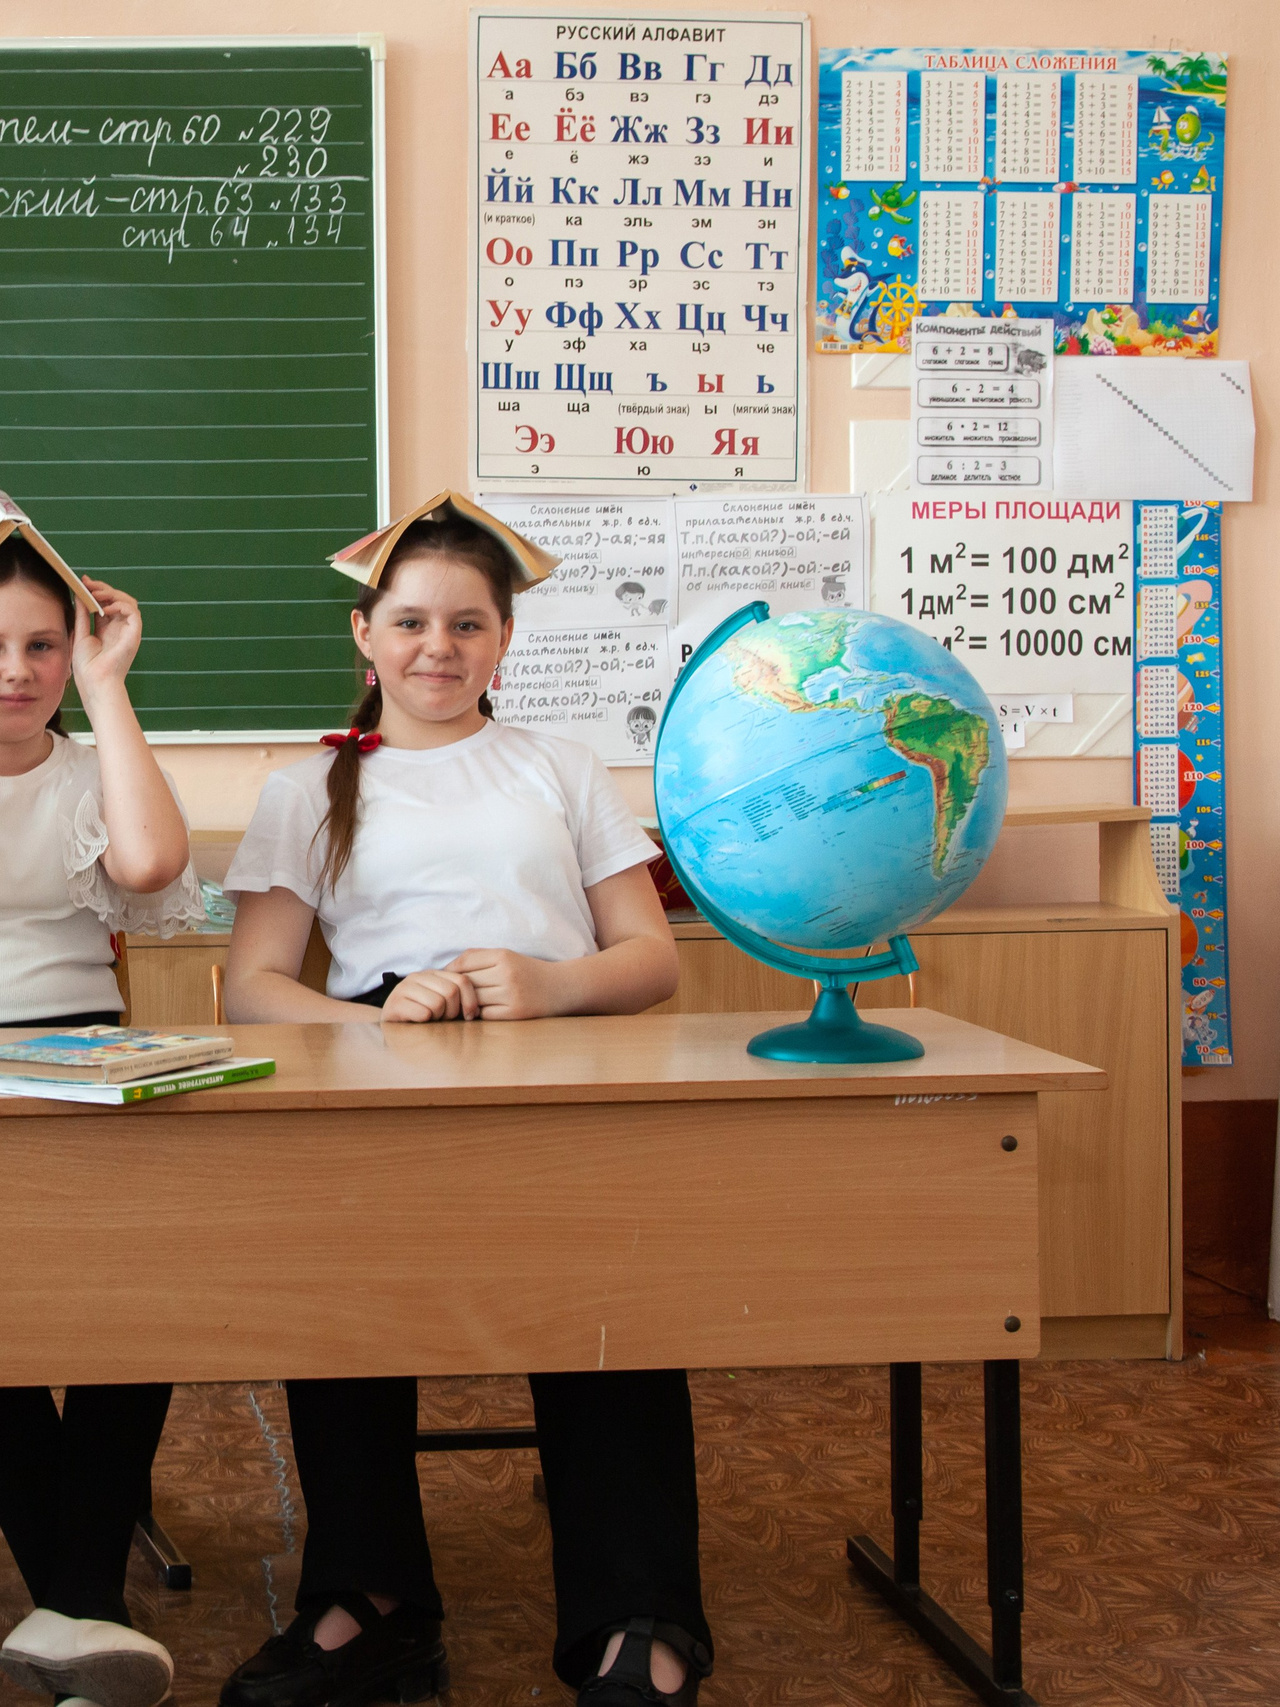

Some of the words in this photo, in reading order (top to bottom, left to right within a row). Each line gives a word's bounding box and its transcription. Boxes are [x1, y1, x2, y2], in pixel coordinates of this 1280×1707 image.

[557, 24, 635, 40] РУССКИЙ
[642, 27, 725, 42] АЛФАВИТ
[487, 51, 532, 78] Аа
[555, 52, 597, 80] Бб
[619, 53, 662, 80] Вв
[685, 54, 724, 81] Гг
[745, 55, 792, 88] Дд
[924, 54, 1009, 72] ТАБЛИЦА
[1015, 55, 1118, 71] СЛОЖЕНИЯ
[505, 90, 513, 100] а
[566, 88, 584, 101] бэ
[630, 93, 648, 102] вэ
[696, 94, 711, 103] гэ
[759, 95, 779, 106] дэ
[490, 113, 530, 141] Ее
[555, 107, 595, 142] Ёё
[611, 116, 668, 143] Жж
[686, 117, 720, 144] Зз
[744, 118, 793, 145] Ии
[505, 150, 513, 159] е
[570, 151, 578, 163] ё
[629, 155, 649, 164] жэ
[695, 156, 711, 165] зэ
[764, 157, 772, 166] и
[486, 168, 533, 203] Йй
[552, 177, 599, 204] Кк
[613, 178, 662, 205] Лл
[674, 179, 730, 206] Мм
[744, 180, 792, 207] Нн
[484, 213, 492, 224] (и
[496, 214, 535, 226] краткое)
[566, 216, 582, 225] ка
[624, 217, 652, 227] эль
[692, 218, 711, 228] эм
[758, 220, 776, 229] эн
[486, 238, 533, 266] Оо
[551, 239, 598, 266] Пп
[618, 241, 659, 275] Рр
[680, 241, 723, 269] Сс
[746, 243, 788, 270] Тт
[505, 277, 514, 286] о
[565, 279, 583, 288] пэ
[629, 279, 647, 292] эр
[693, 281, 710, 290] эс
[758, 282, 774, 291] тэ
[487, 300, 532, 335] Уу
[546, 302, 603, 336] Фф
[615, 302, 661, 329] Хх
[678, 304, 726, 337] Цц
[744, 305, 788, 332] Чч
[505, 339, 513, 352] у
[564, 337, 586, 353] эф
[630, 341, 646, 351] ха
[693, 343, 710, 354] цэ
[757, 344, 774, 353] че
[482, 362, 539, 390] Шш
[555, 364, 613, 397] Щщ
[499, 402, 520, 411] ша
[568, 403, 589, 414] ща
[618, 403, 663, 415] (твёрдый
[667, 405, 689, 416] знак)
[705, 405, 717, 414] ы
[733, 404, 769, 415] (мягкий
[772, 405, 795, 416] знак)
[515, 425, 555, 453] Ээ
[614, 427, 674, 455] Юю
[711, 429, 759, 455] Яя
[532, 465, 539, 474] э
[638, 466, 650, 475] ю
[735, 467, 743, 476] я
[723, 503, 783, 512] Склонение
[912, 501, 986, 519] МЕРЫ
[995, 502, 1120, 523] ПЛОЩАДИ
[686, 516, 784, 527] прилагательных
[564, 552, 598, 560] книга
[682, 548, 749, 560] интересной
[755, 548, 794, 557] книгой
[901, 547, 912, 573] 1
[971, 554, 989, 566] =
[1003, 547, 1056, 574] 100
[1184, 566, 1201, 574] 140
[707, 581, 775, 592] интересной
[780, 581, 811, 589] книге
[971, 595, 988, 607] =
[1002, 588, 1056, 614] 100
[528, 633, 588, 643] Склонение
[594, 631, 621, 640] имён
[969, 636, 987, 649] =
[1000, 629, 1083, 656] 10000
[1184, 636, 1201, 644] 130
[1000, 704, 1008, 716] S
[1025, 705, 1035, 716] V
[1053, 707, 1058, 716] t
[1184, 772, 1202, 780] 110
[1186, 841, 1204, 849] 100
[1192, 909, 1204, 917] 90
[1193, 978, 1206, 986] 80
[1197, 1046, 1208, 1054] 70
